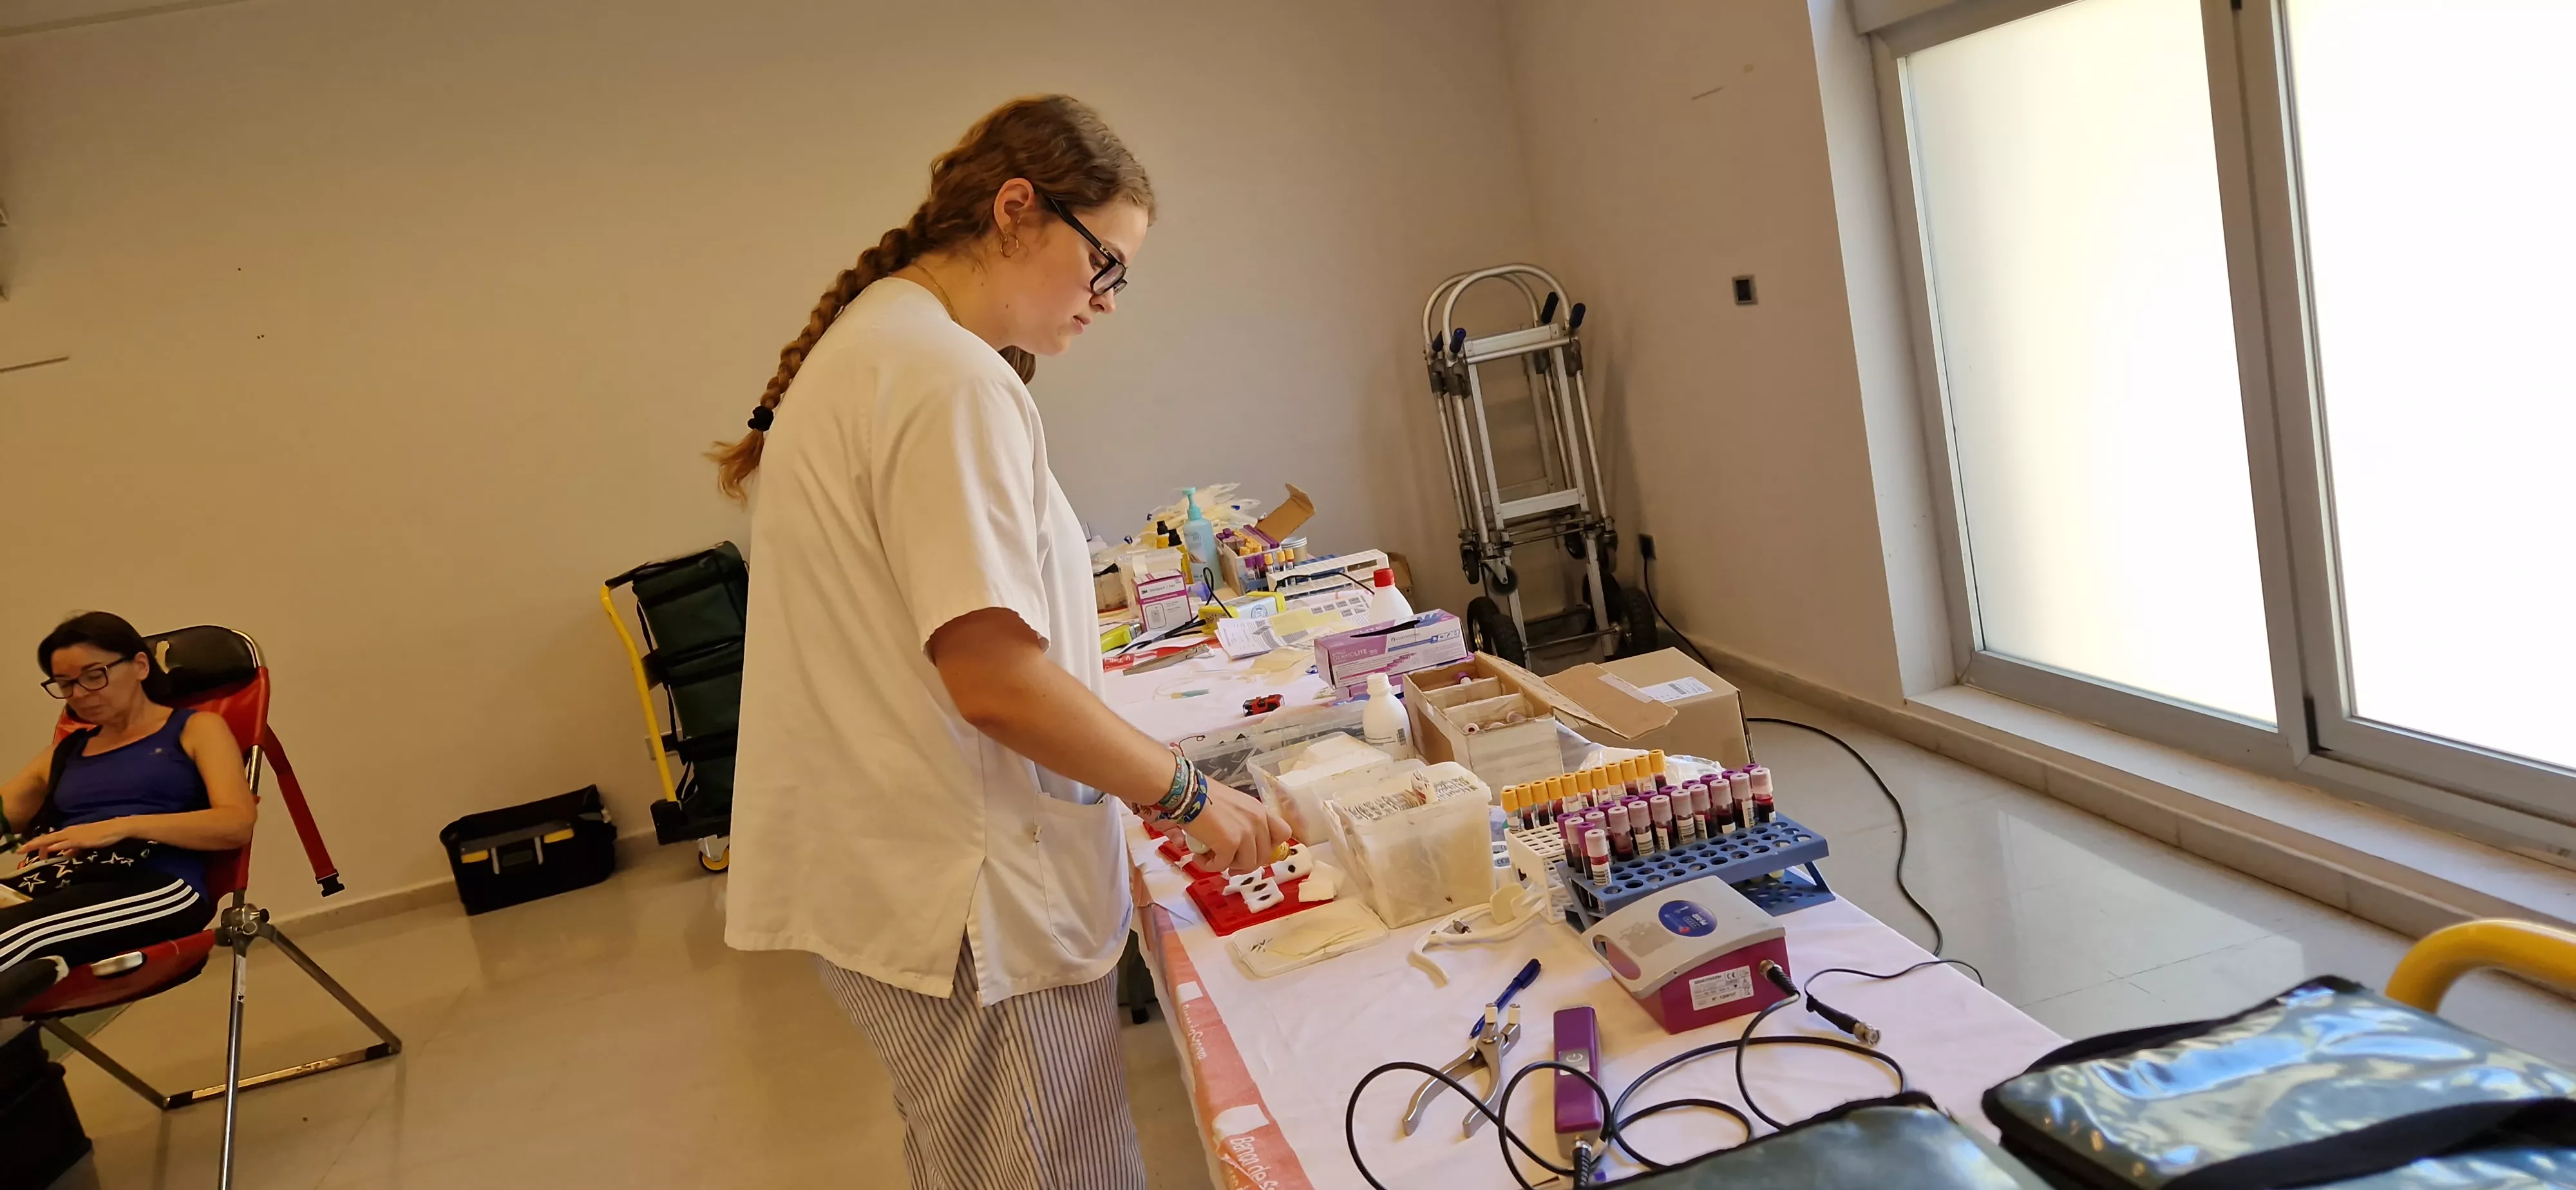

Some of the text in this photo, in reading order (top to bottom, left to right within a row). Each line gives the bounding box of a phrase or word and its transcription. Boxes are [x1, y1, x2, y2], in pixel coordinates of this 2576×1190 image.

[1332, 648, 1368, 661] DERMOLITE
[1229, 1136, 1260, 1166] Banco
[1247, 1165, 1271, 1182] de
